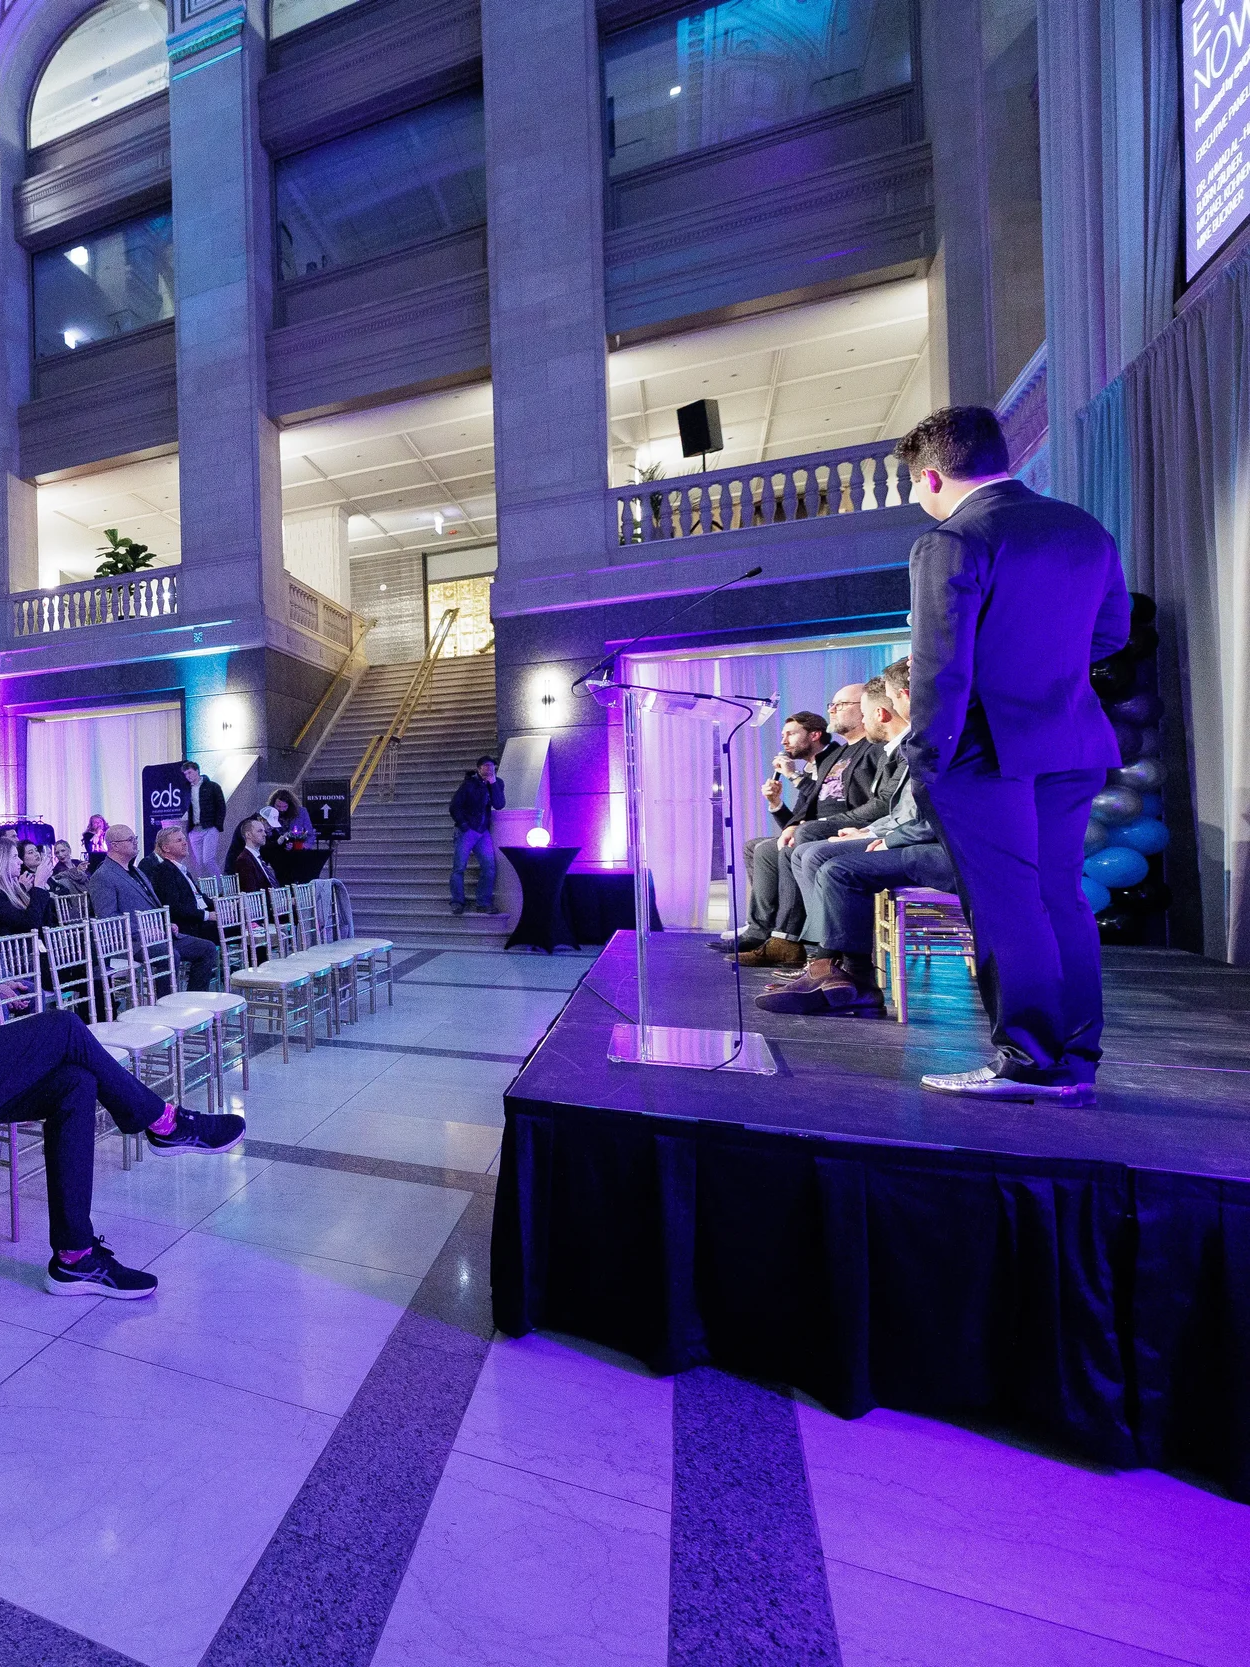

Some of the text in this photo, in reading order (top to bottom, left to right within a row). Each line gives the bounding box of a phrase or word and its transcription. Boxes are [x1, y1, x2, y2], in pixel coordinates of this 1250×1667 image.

[1196, 112, 1229, 164] EXECUTIVE
[1196, 194, 1224, 234] MICHAEL
[1196, 187, 1244, 251] MIKE BUCKNER
[150, 782, 181, 808] eds
